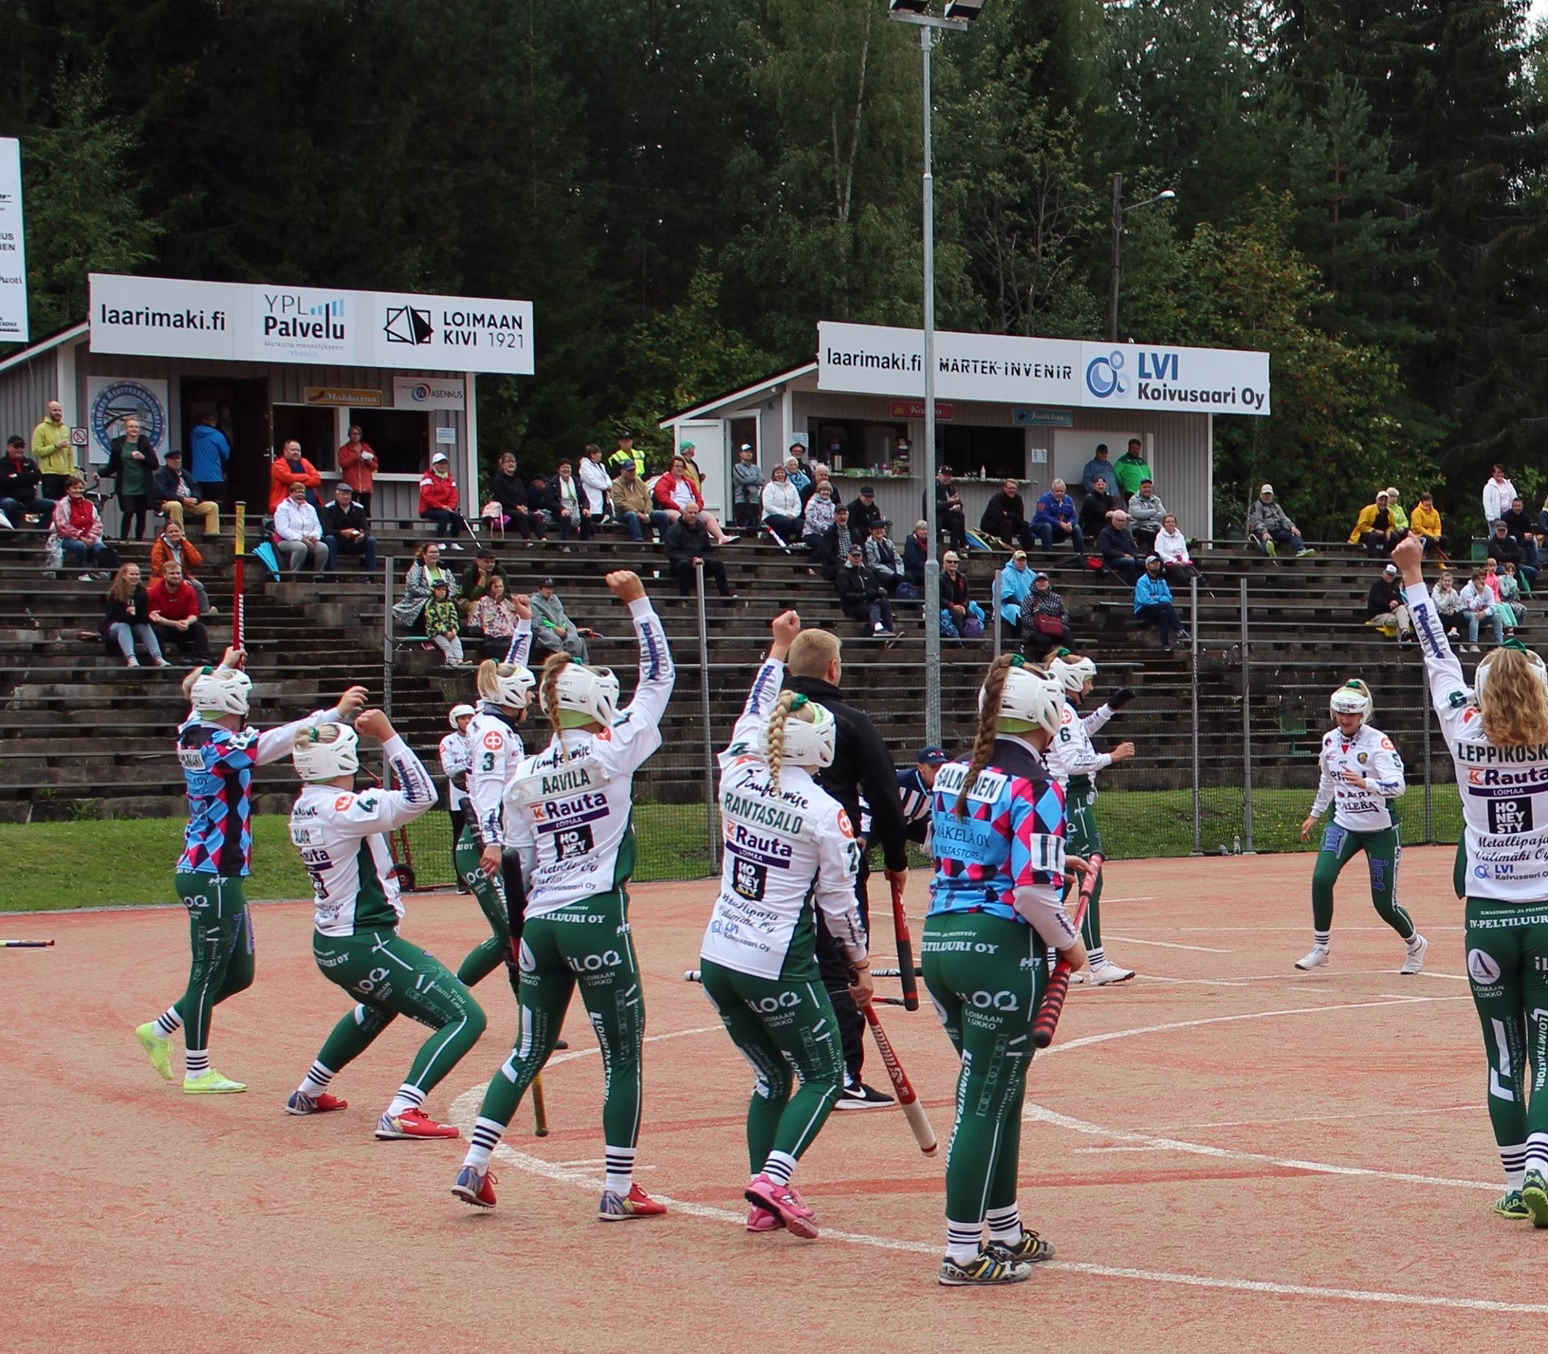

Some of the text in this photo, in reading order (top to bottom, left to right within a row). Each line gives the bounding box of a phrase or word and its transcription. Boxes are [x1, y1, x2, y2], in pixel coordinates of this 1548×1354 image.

[264, 293, 309, 316] YPL
[101, 303, 226, 332] laarimaki.fi
[264, 303, 345, 340] Palvelu
[443, 311, 523, 331] LOIMAAN
[443, 330, 524, 349] KIVI 1921
[827, 347, 922, 372] laarimaki.fi
[1138, 352, 1179, 381] LVI
[430, 388, 463, 399] ASENNUS
[1138, 382, 1265, 411] Koivusaari Oy
[1059, 726, 1071, 743] 6
[483, 751, 495, 772] 3
[541, 767, 592, 795] AAVILA
[938, 767, 1000, 799] SALNEN
[1493, 788, 1525, 796] LOIMAA
[357, 797, 378, 813] 4
[545, 792, 608, 819] Rauta
[1495, 801, 1518, 813] HO
[724, 791, 803, 835] RANTASALO
[1495, 811, 1525, 824] NEY
[555, 816, 584, 829] LOIMAA
[1497, 822, 1524, 834] STY
[559, 831, 579, 844] HO
[736, 825, 793, 858] Rauta
[976, 833, 990, 848] OY
[738, 861, 755, 876] HO
[1495, 864, 1514, 874] LVI
[737, 874, 760, 889] NEY
[1495, 872, 1541, 881] Koivusaari
[588, 915, 606, 924] OY
[974, 943, 999, 954] OY
[1477, 990, 1503, 998] LUKKO
[965, 1009, 1003, 1024] LOIMAAN
[968, 1017, 996, 1030] LUKKO
